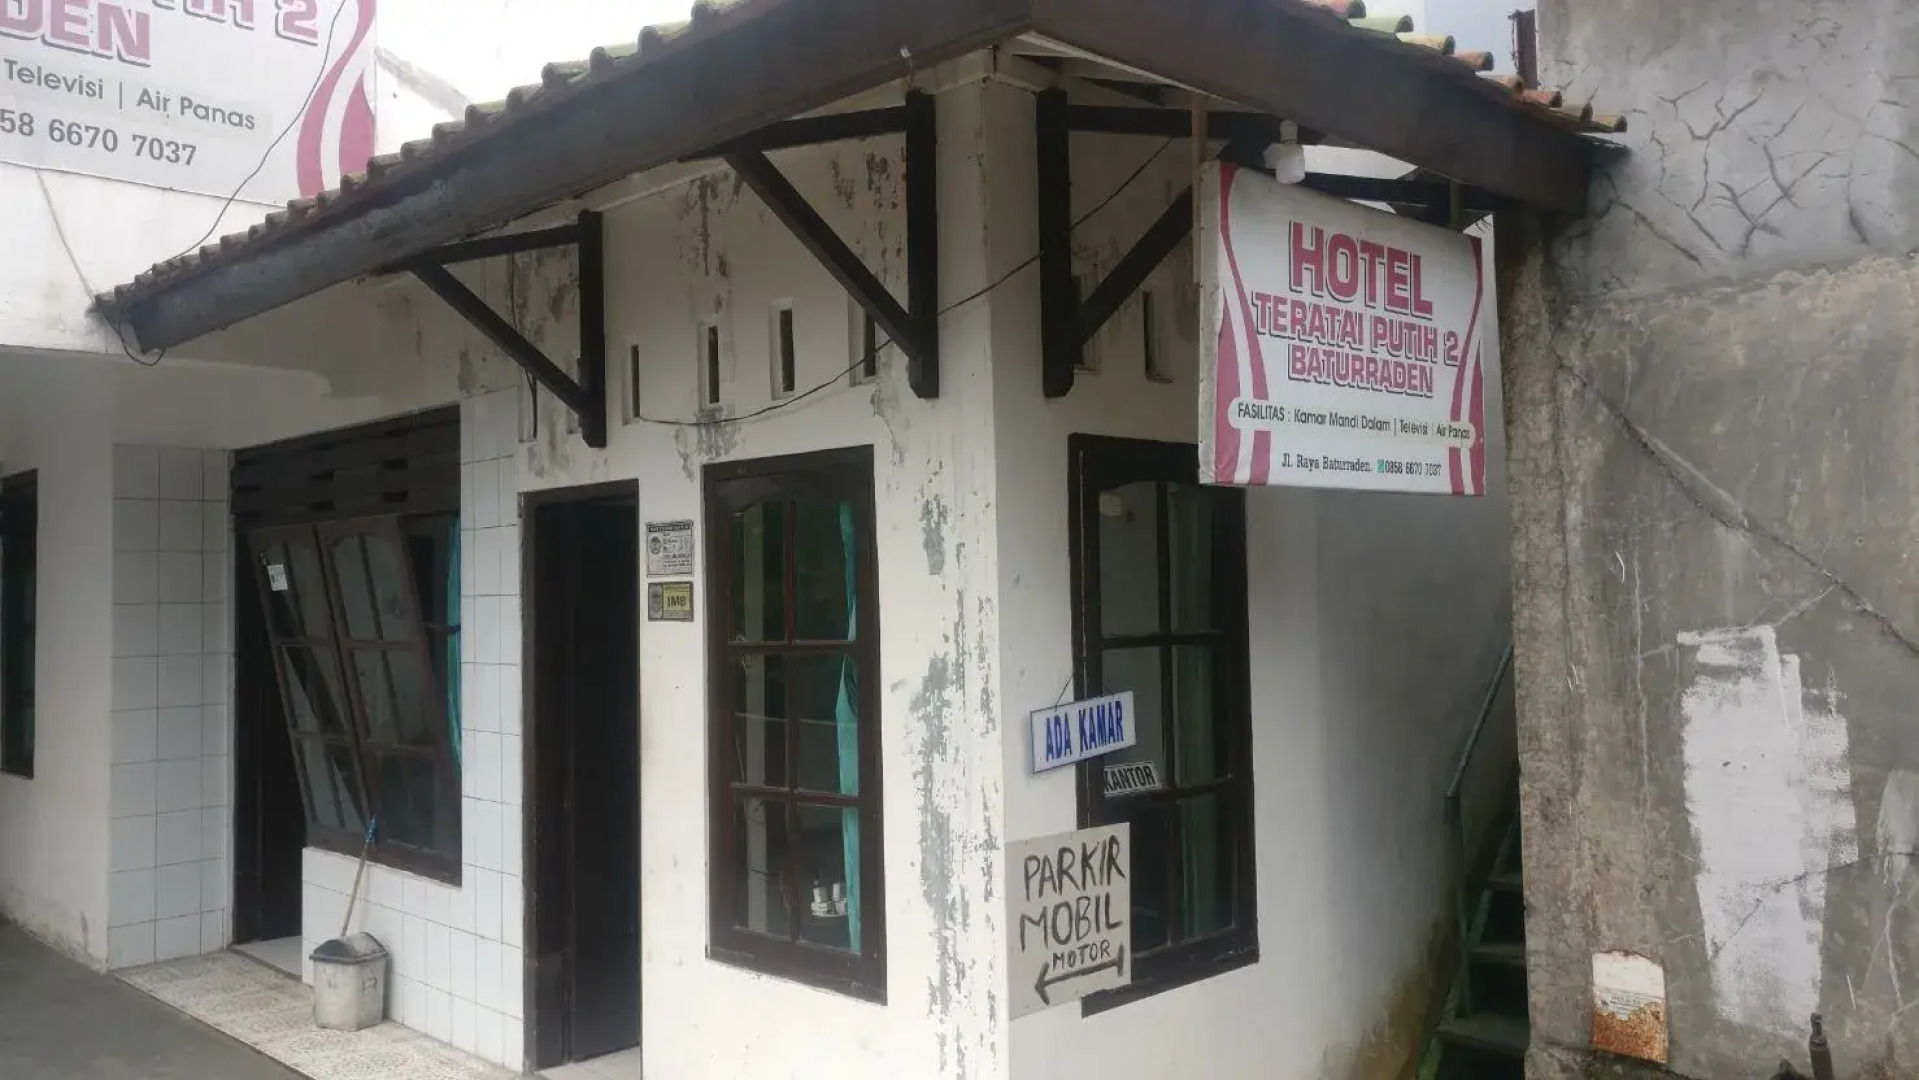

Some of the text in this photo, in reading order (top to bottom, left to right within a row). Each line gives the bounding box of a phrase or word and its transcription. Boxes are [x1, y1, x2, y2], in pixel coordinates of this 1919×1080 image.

[275, 0, 319, 46] 2
[3, 58, 104, 100] Televisi
[136, 88, 171, 112] Air
[180, 97, 256, 131] Panas
[49, 119, 118, 152] 6670
[132, 134, 198, 167] 7037
[1289, 220, 1433, 321] HOTEL
[1252, 289, 1459, 366] TERATAI PUTIH 2
[1288, 343, 1433, 398] BATURRADEN
[1238, 402, 1285, 422] FASILITAS
[1294, 409, 1327, 425] Kamar
[1329, 412, 1359, 429] Mandi
[1361, 415, 1391, 431] Dalam
[1400, 419, 1428, 435] Televisi
[1448, 424, 1471, 439] Panas
[1296, 454, 1320, 471] Raya
[1045, 700, 1125, 763] ADA KAMAR
[1104, 765, 1156, 792] KANTOR
[1024, 834, 1126, 902] PARKIR
[1019, 892, 1123, 952] MOBIL
[1052, 938, 1111, 971] MOTOR
